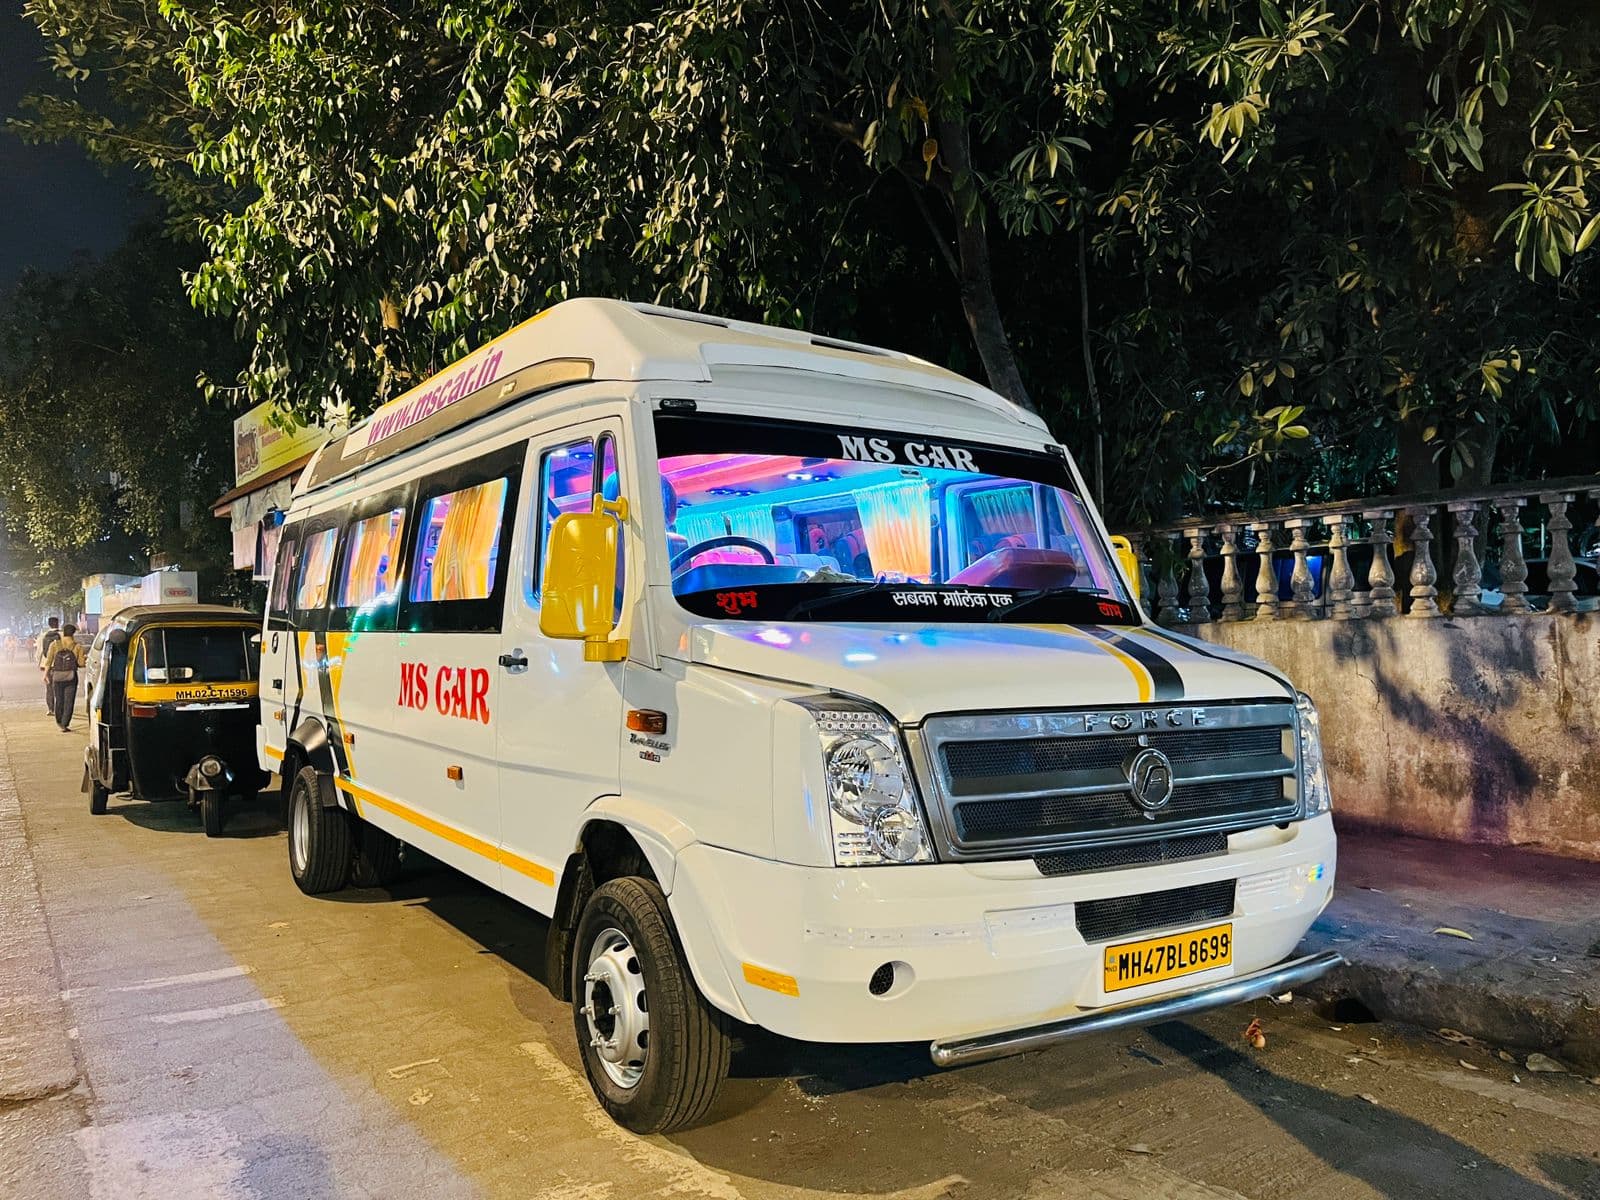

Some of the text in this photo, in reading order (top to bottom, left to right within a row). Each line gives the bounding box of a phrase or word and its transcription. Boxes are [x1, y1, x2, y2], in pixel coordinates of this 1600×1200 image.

[367, 347, 503, 445] www.mscar.in
[837, 435, 980, 473] MS CAR
[715, 591, 758, 615] शुभ
[890, 589, 1013, 608] सबका मालिक एक
[175, 689, 248, 700] MH.02.CT.1596
[398, 662, 490, 725] MS CAR
[1084, 707, 1206, 732] FORCE
[1118, 933, 1229, 981] MH47BL8699
